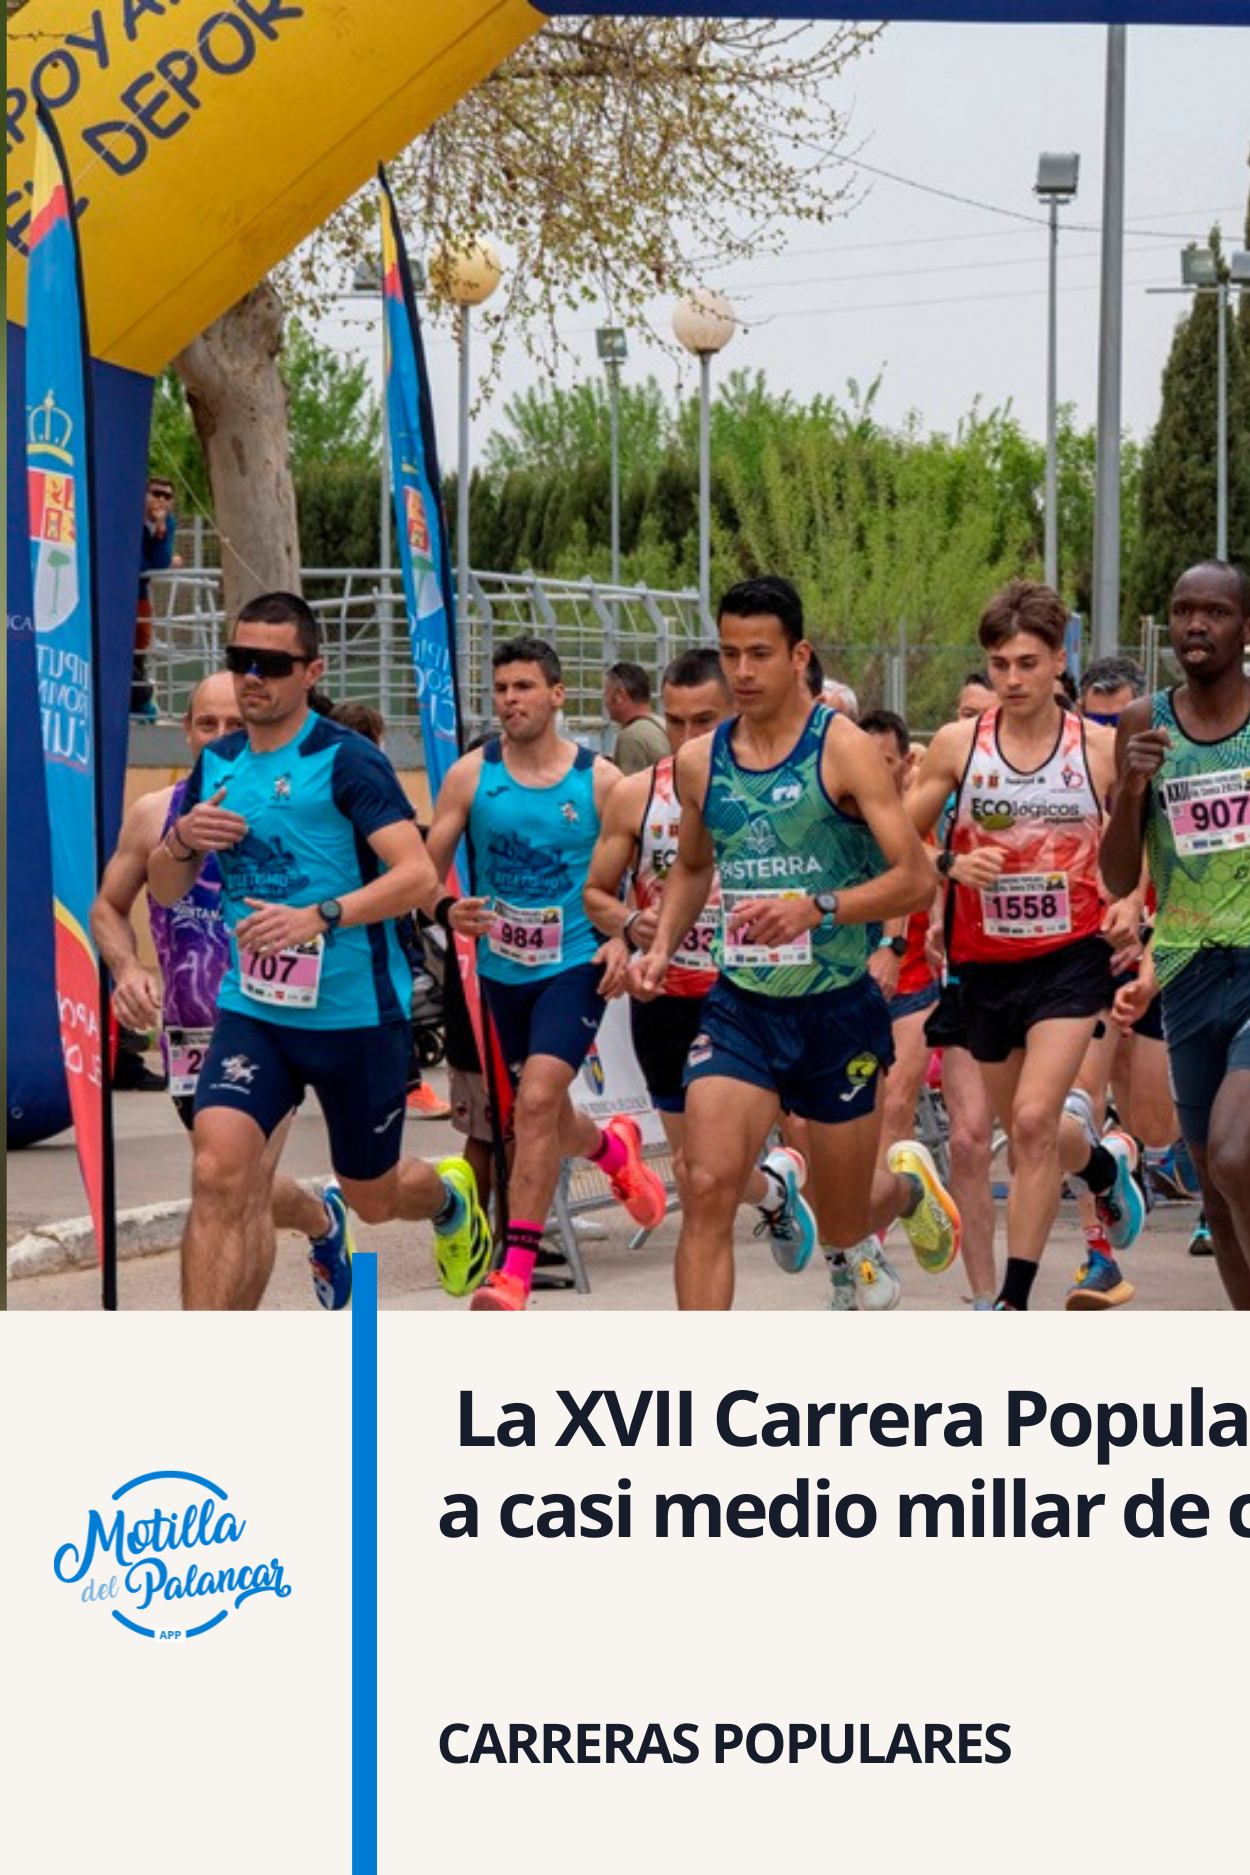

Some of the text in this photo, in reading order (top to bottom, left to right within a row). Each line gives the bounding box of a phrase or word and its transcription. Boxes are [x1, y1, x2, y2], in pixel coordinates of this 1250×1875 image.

[1191, 795, 1250, 832] 907
[992, 895, 1057, 920] 1558
[501, 925, 544, 949] 984
